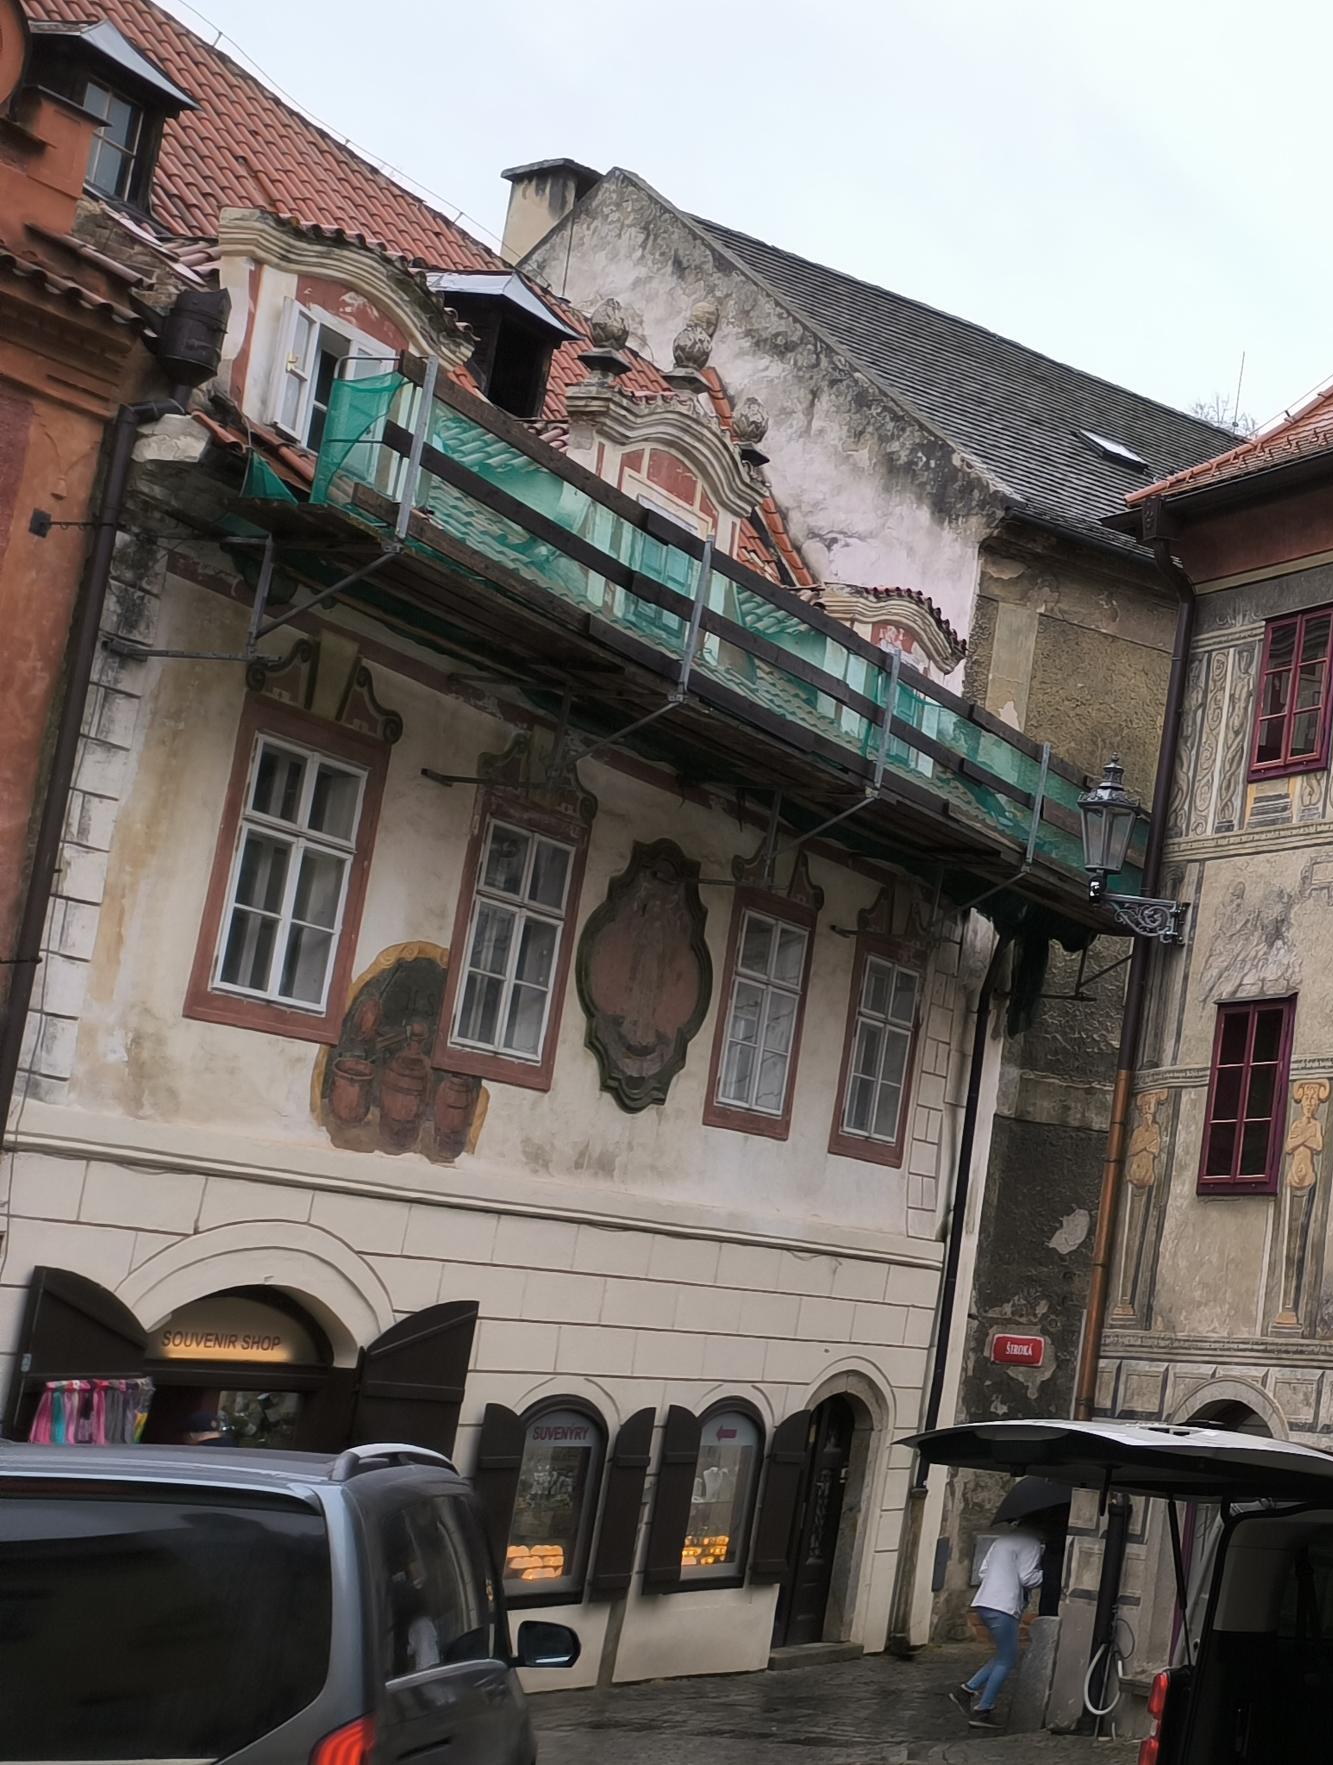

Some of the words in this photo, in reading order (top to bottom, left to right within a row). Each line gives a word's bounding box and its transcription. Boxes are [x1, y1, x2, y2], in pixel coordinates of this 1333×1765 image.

[162, 1330, 238, 1349] SOUVENIR
[241, 1335, 280, 1351] SHOP
[1005, 1341, 1033, 1356] ŠIROKÁ
